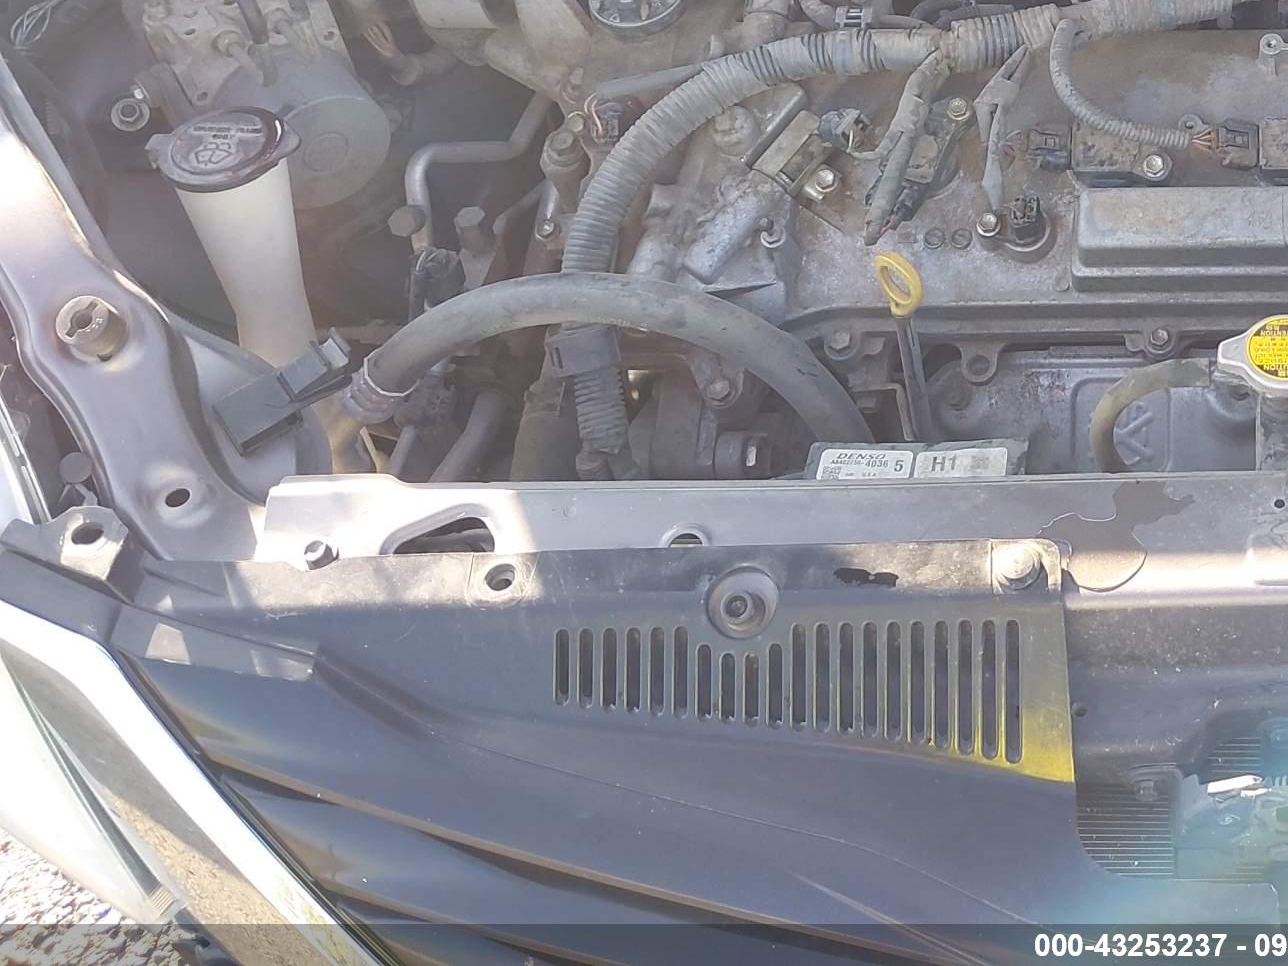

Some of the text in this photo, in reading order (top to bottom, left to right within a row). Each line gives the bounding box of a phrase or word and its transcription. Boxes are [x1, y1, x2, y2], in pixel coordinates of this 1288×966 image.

[836, 452, 887, 460] DENSO
[894, 459, 904, 473] 5
[931, 455, 957, 472] H1
